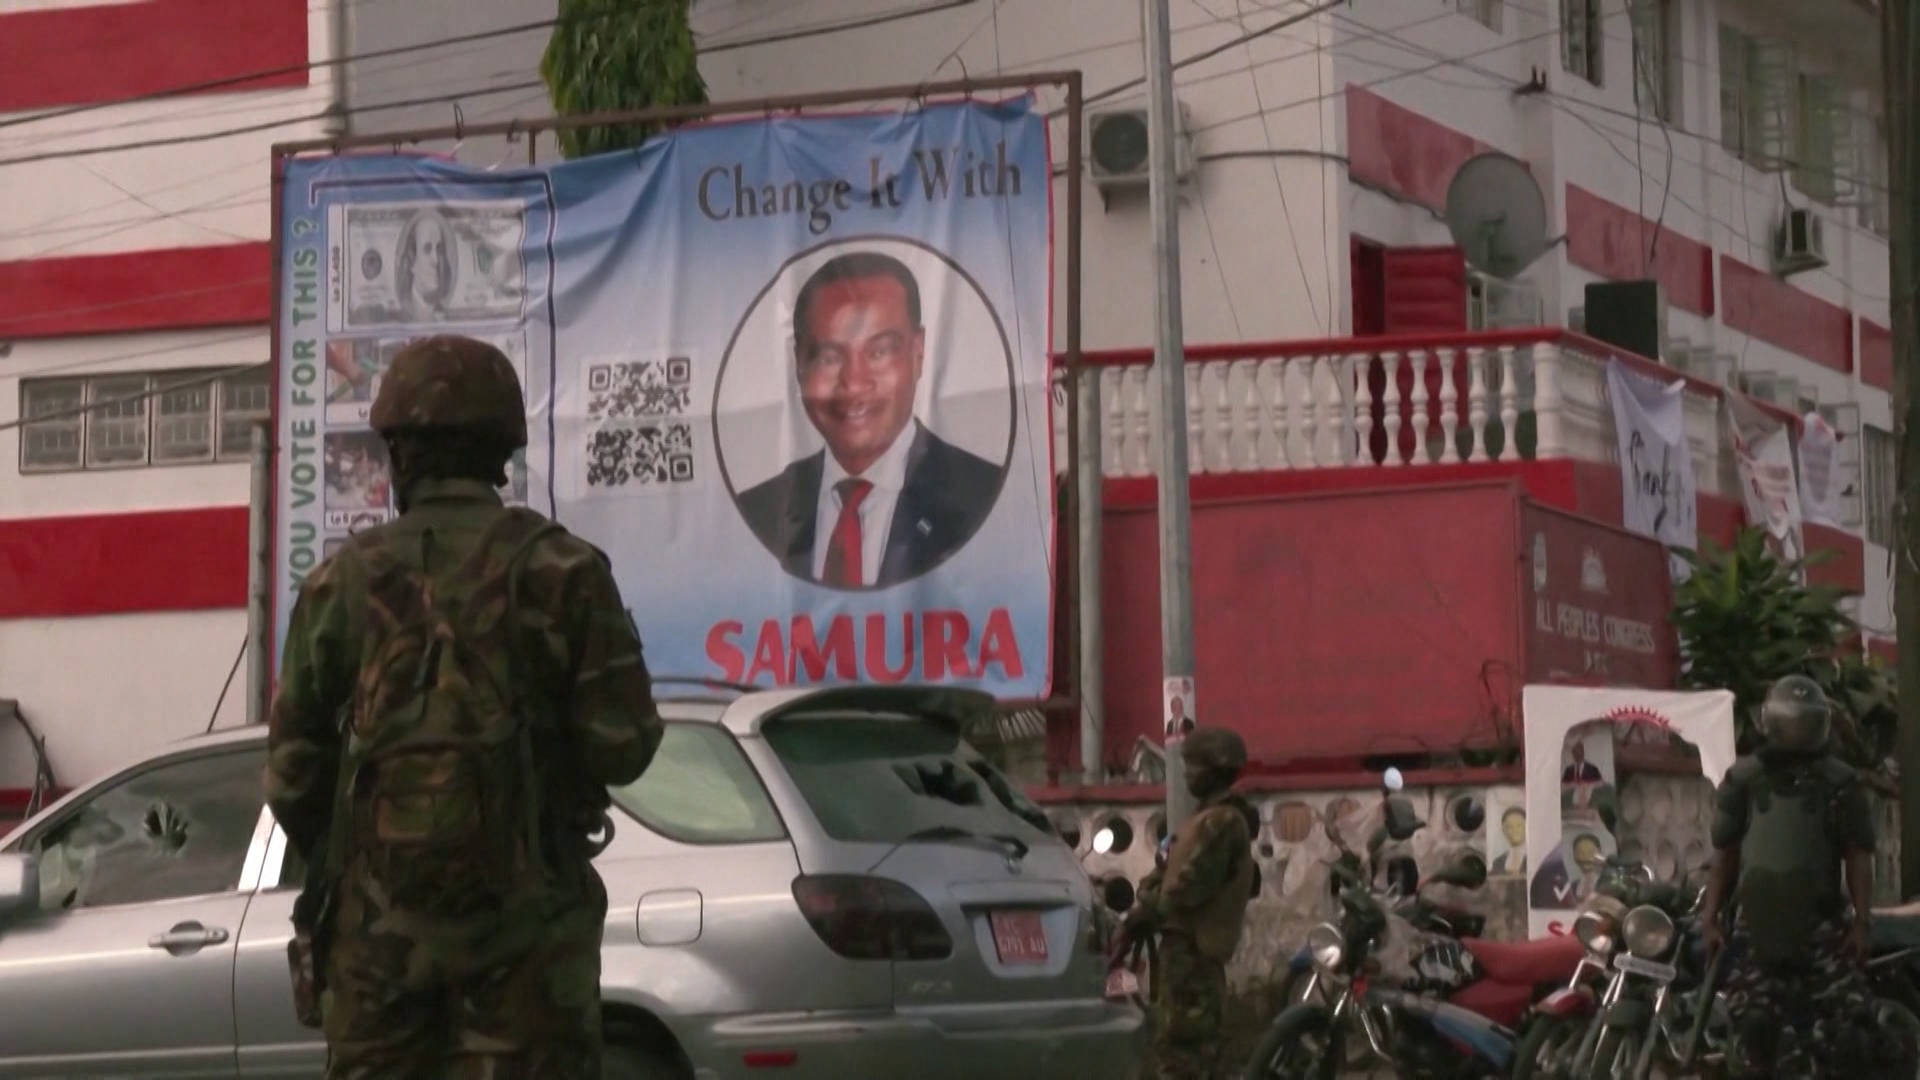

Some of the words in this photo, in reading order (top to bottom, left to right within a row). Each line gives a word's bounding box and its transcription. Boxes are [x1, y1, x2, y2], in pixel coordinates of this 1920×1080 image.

[294, 218, 318, 234] ?
[698, 163, 852, 234] Change
[869, 158, 901, 209] It
[914, 140, 1022, 201] With
[292, 249, 317, 327] THIS
[291, 338, 317, 407] FOR
[290, 418, 317, 510] VOTE
[704, 606, 1026, 690] SAMURA
